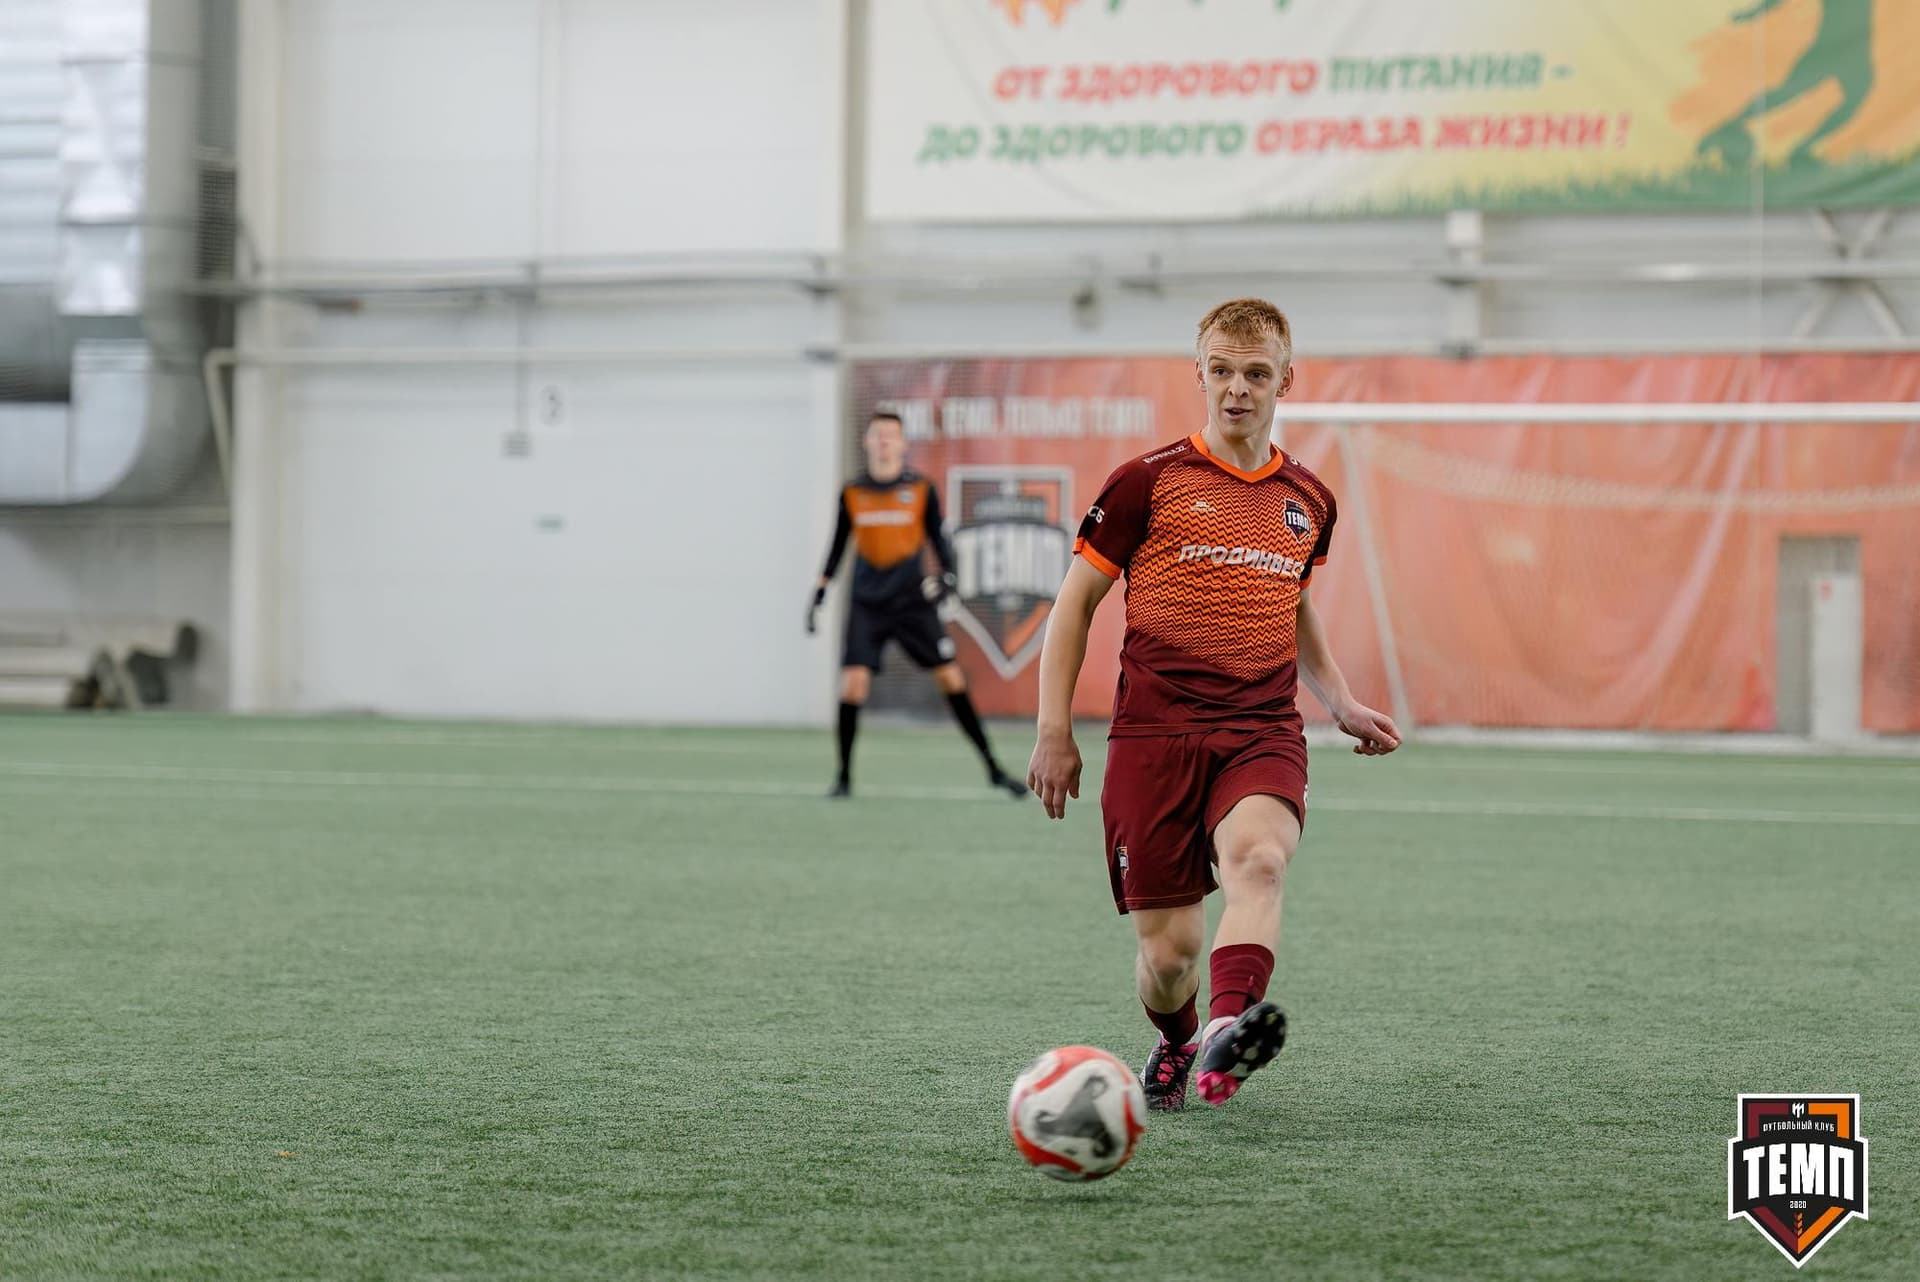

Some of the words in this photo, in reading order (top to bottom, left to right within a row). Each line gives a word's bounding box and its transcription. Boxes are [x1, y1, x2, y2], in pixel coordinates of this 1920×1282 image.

[994, 65, 1047, 101] ОТ
[1058, 60, 1317, 104] ЗДОРОВОГО
[1328, 53, 1543, 91] ПИТАНИЯ
[916, 123, 980, 162] ДО
[989, 121, 1244, 163] ЗДОРОВОГО
[1256, 115, 1421, 154] ОБРАЗА
